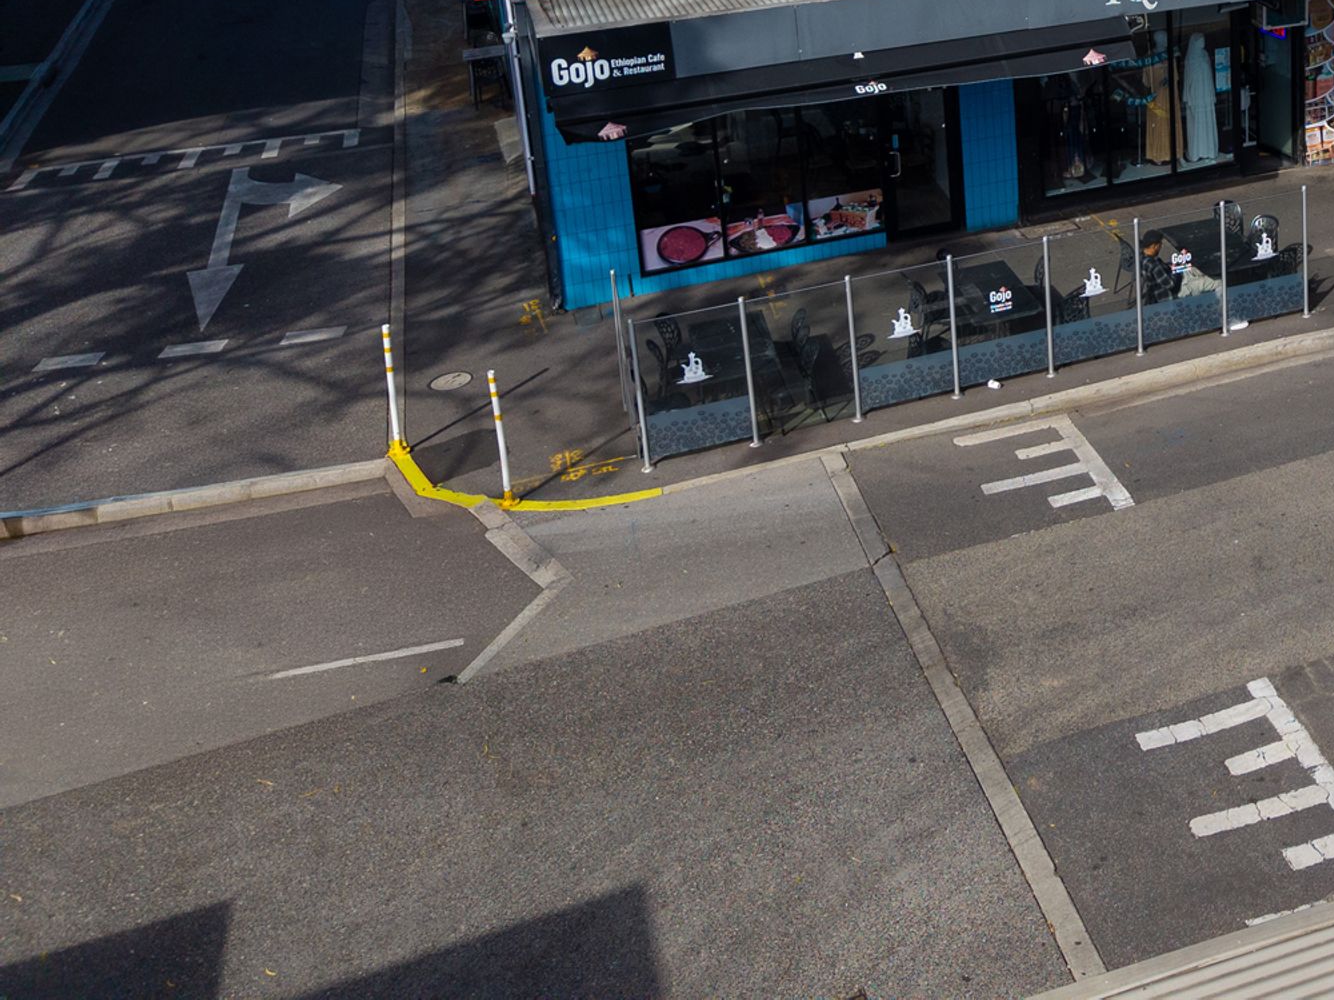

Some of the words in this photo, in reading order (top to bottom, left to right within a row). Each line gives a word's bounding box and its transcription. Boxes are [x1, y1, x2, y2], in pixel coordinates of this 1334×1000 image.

[611, 56, 647, 68] Ethiopian
[647, 53, 665, 64] Cafe
[551, 58, 610, 88] Gojo
[612, 69, 622, 77] &
[623, 63, 665, 75] Restaurant
[990, 290, 1012, 303] Gojo
